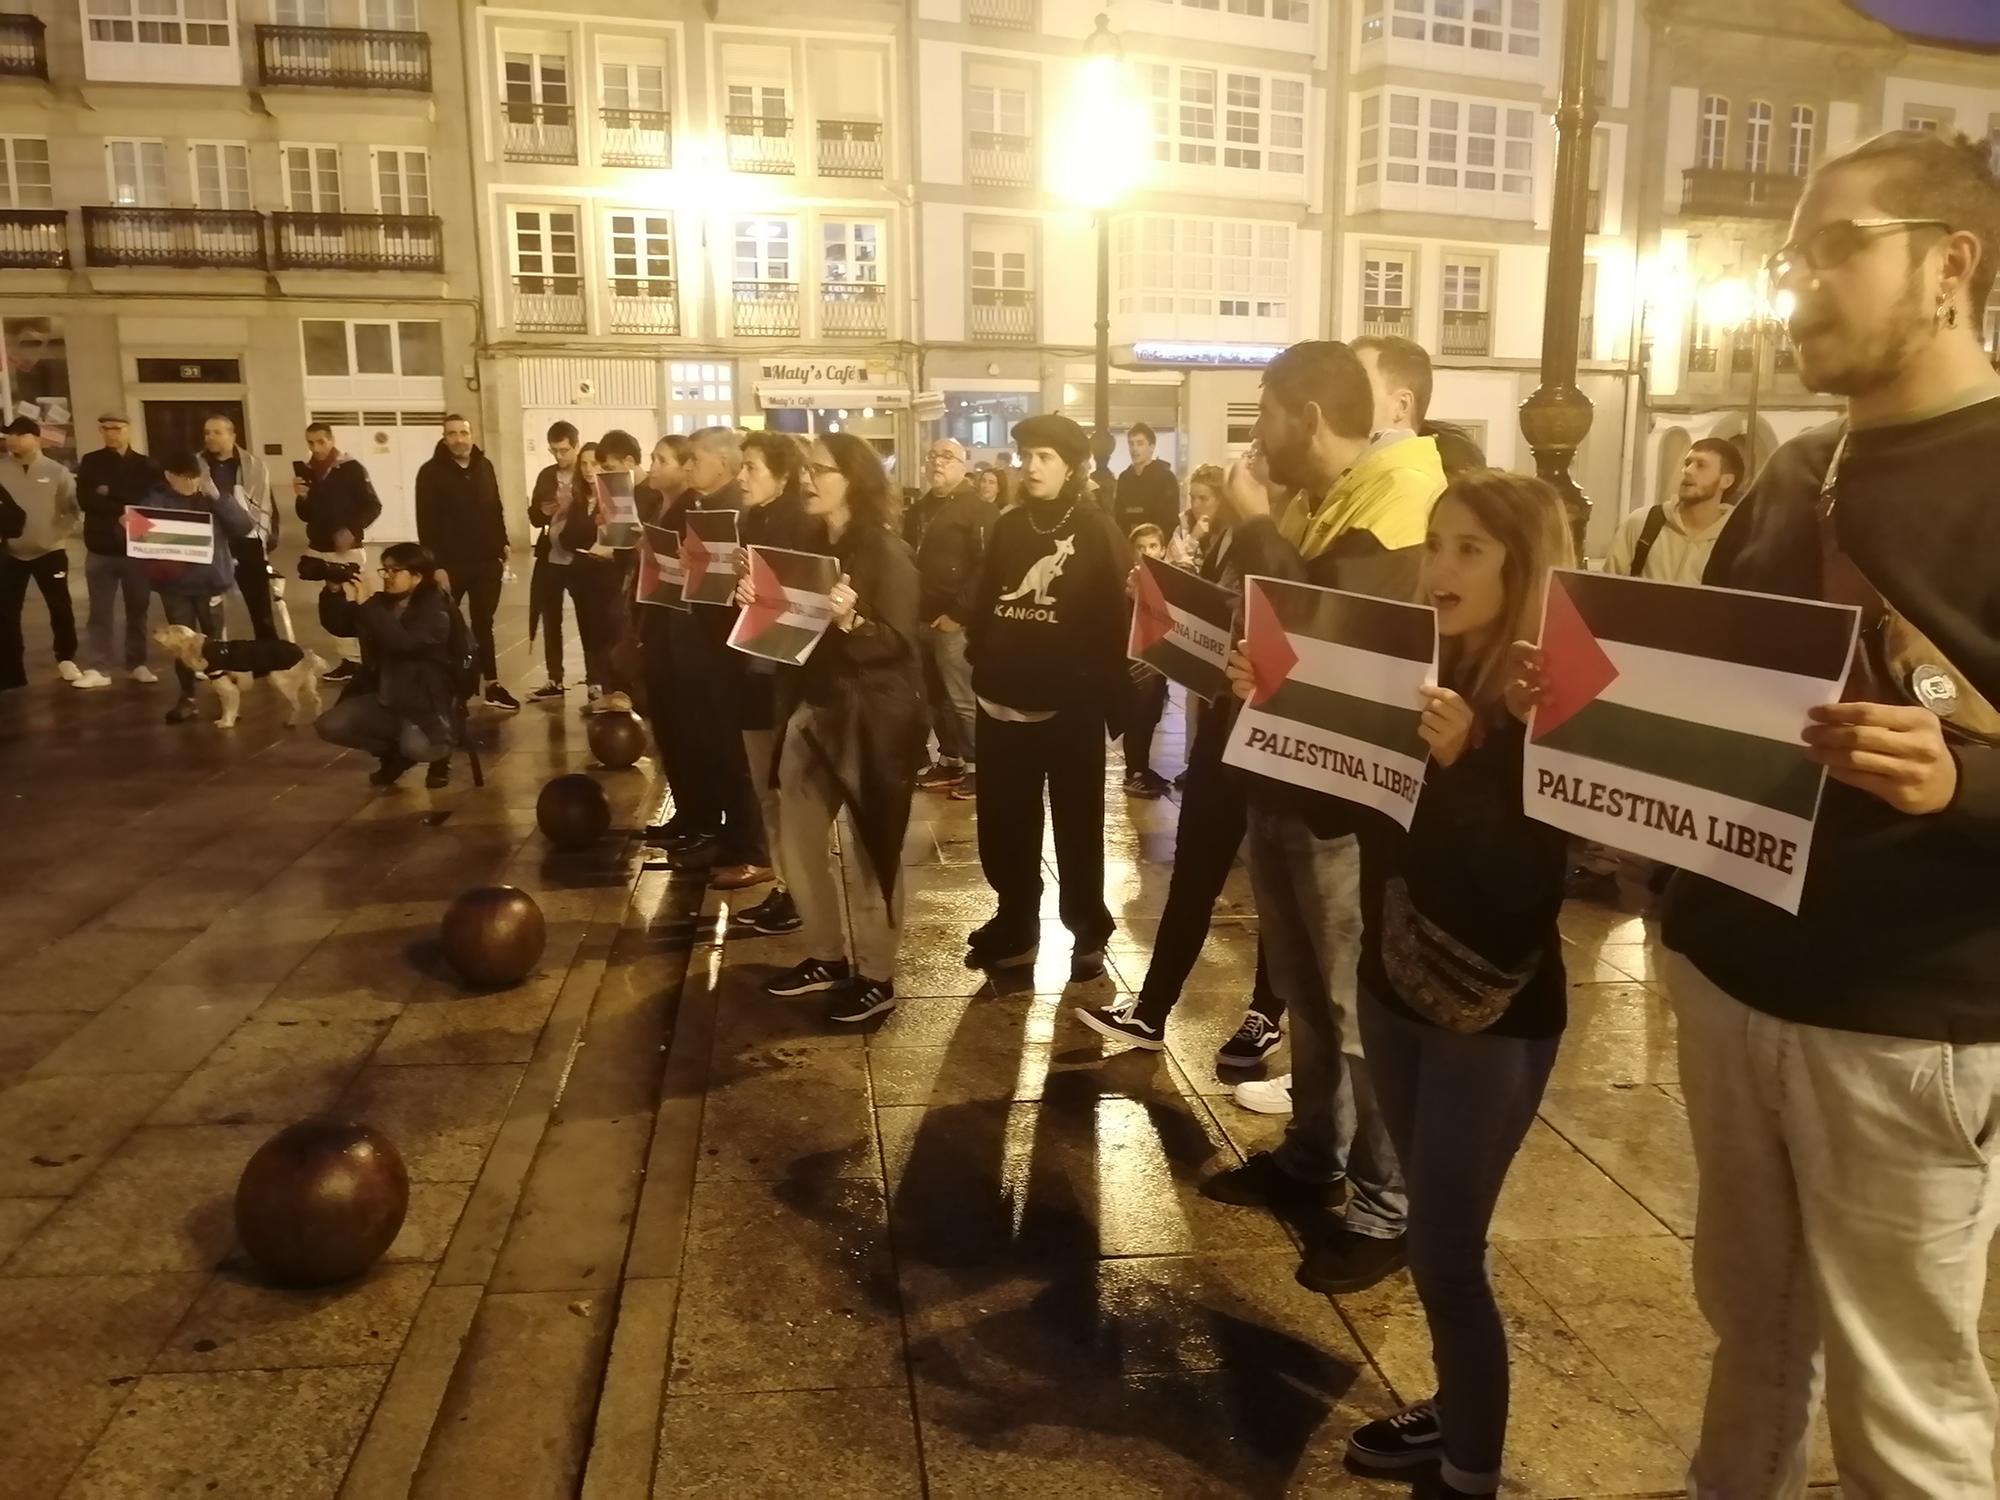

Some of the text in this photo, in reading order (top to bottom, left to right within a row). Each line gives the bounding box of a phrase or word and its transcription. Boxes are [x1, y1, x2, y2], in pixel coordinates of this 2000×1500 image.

[826, 365, 856, 384] Café
[993, 604, 1059, 624] KANGOL
[1193, 630, 1225, 656] LIBRE
[1245, 727, 1368, 782] PALESTINA
[1538, 768, 1798, 875] PALESTINA LIBRE
